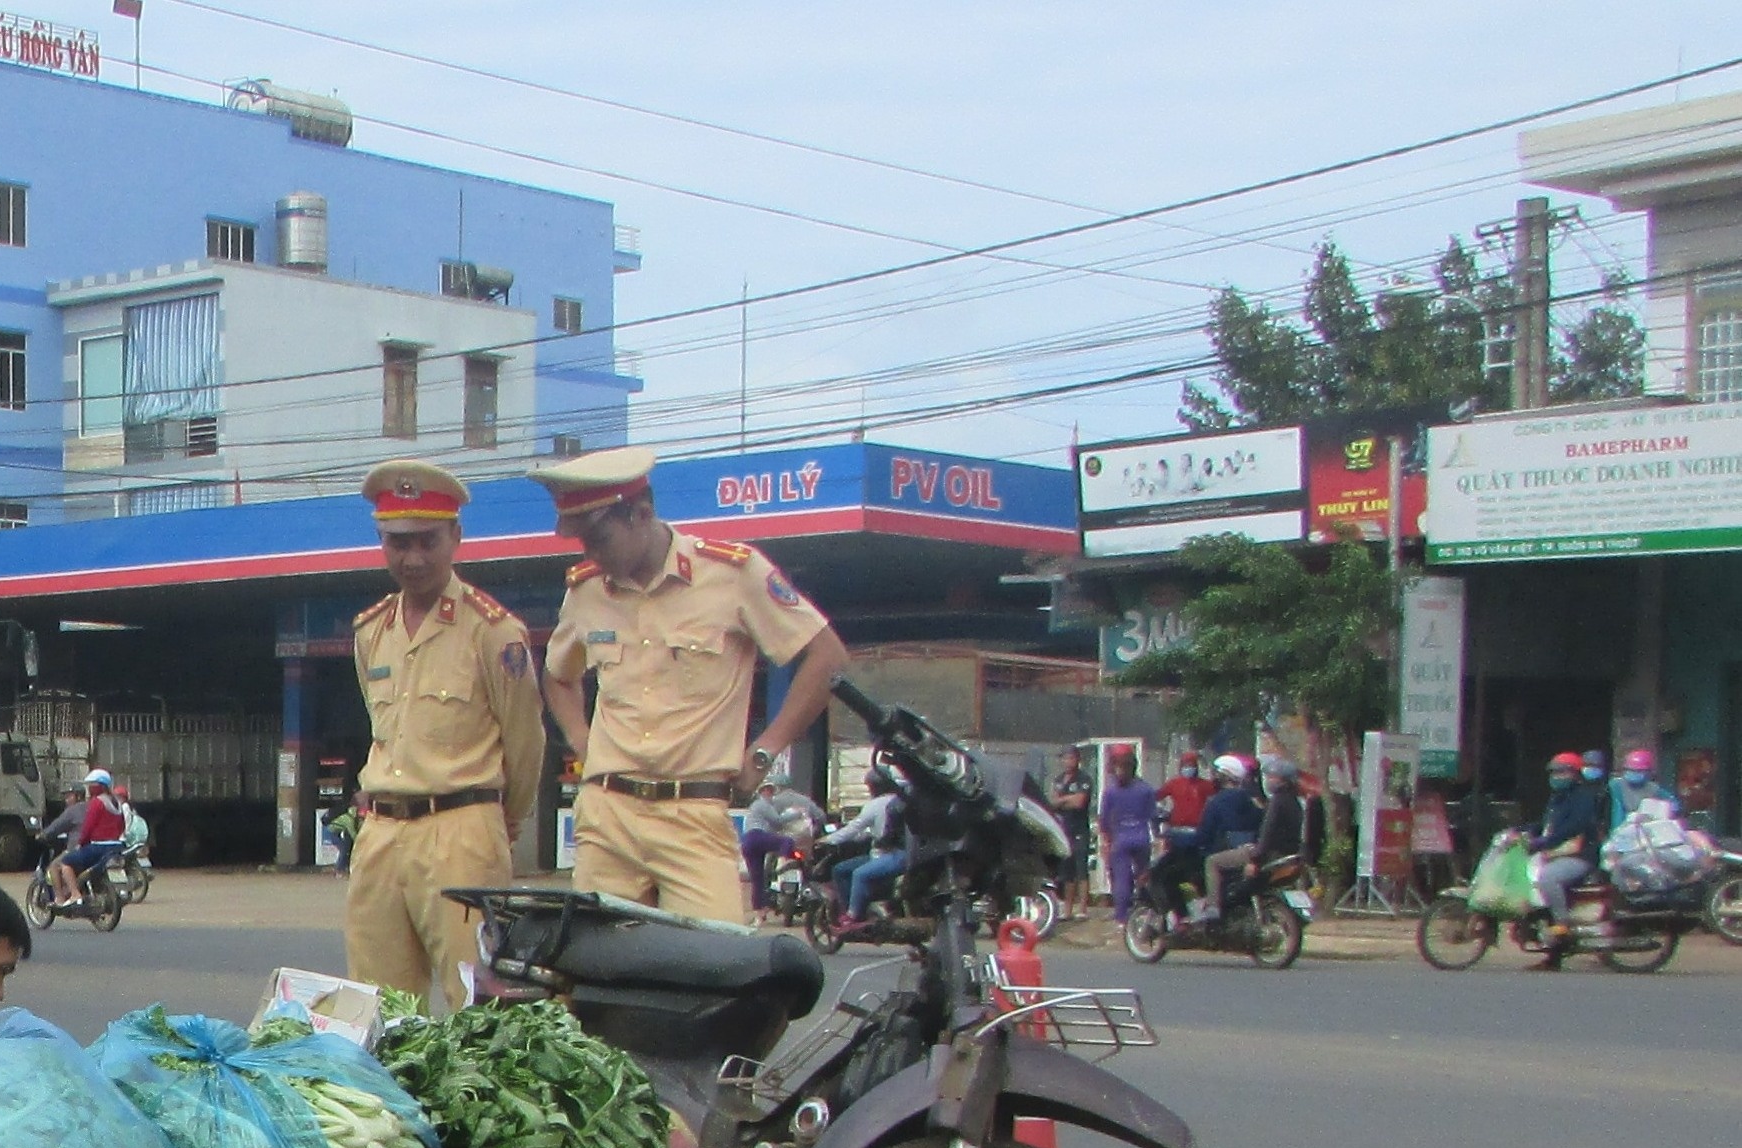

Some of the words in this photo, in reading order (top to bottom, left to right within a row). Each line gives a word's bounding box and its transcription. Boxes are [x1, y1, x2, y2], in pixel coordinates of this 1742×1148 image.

[67, 29, 100, 77] VÂN
[1566, 436, 1689, 459] BAMEPHARM
[1597, 460, 1673, 482] DOANH
[716, 473, 771, 513] ĐẠI
[779, 461, 823, 501] LÝ
[891, 456, 939, 504] PV
[943, 465, 1001, 511] OIL
